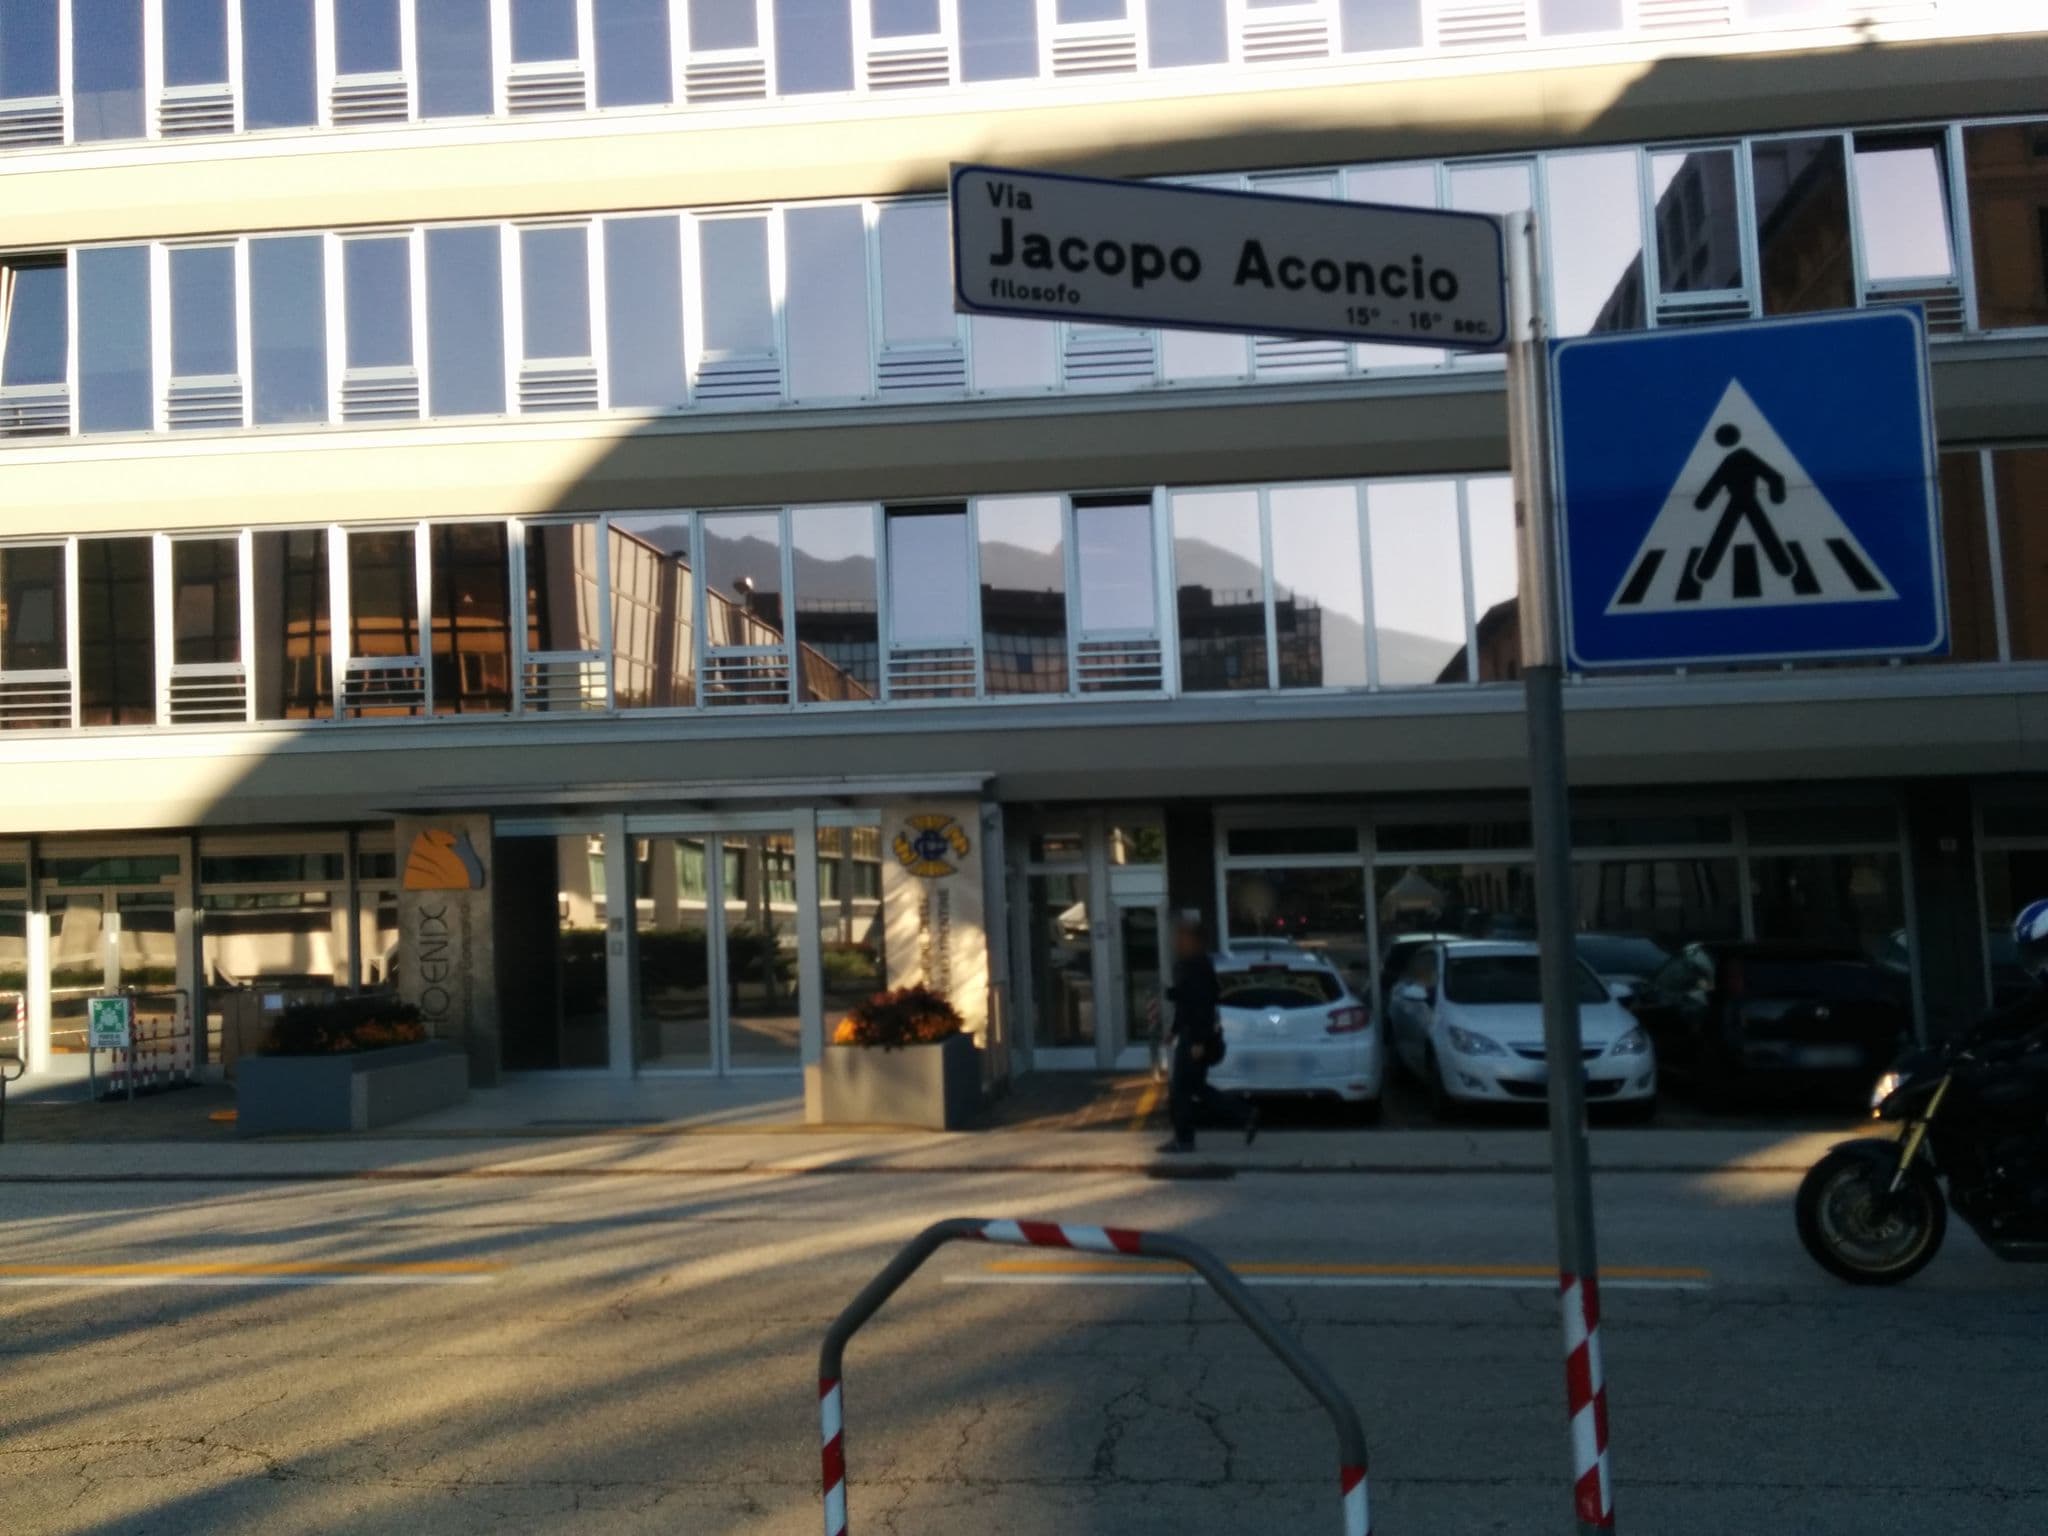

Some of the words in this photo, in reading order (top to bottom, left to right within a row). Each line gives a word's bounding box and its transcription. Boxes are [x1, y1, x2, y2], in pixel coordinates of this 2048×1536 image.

[987, 181, 1033, 211] Via
[989, 216, 1203, 290] Jacopo
[1233, 238, 1460, 302] Aconcio
[989, 277, 1082, 305] filosofo
[1452, 319, 1494, 336] sec.
